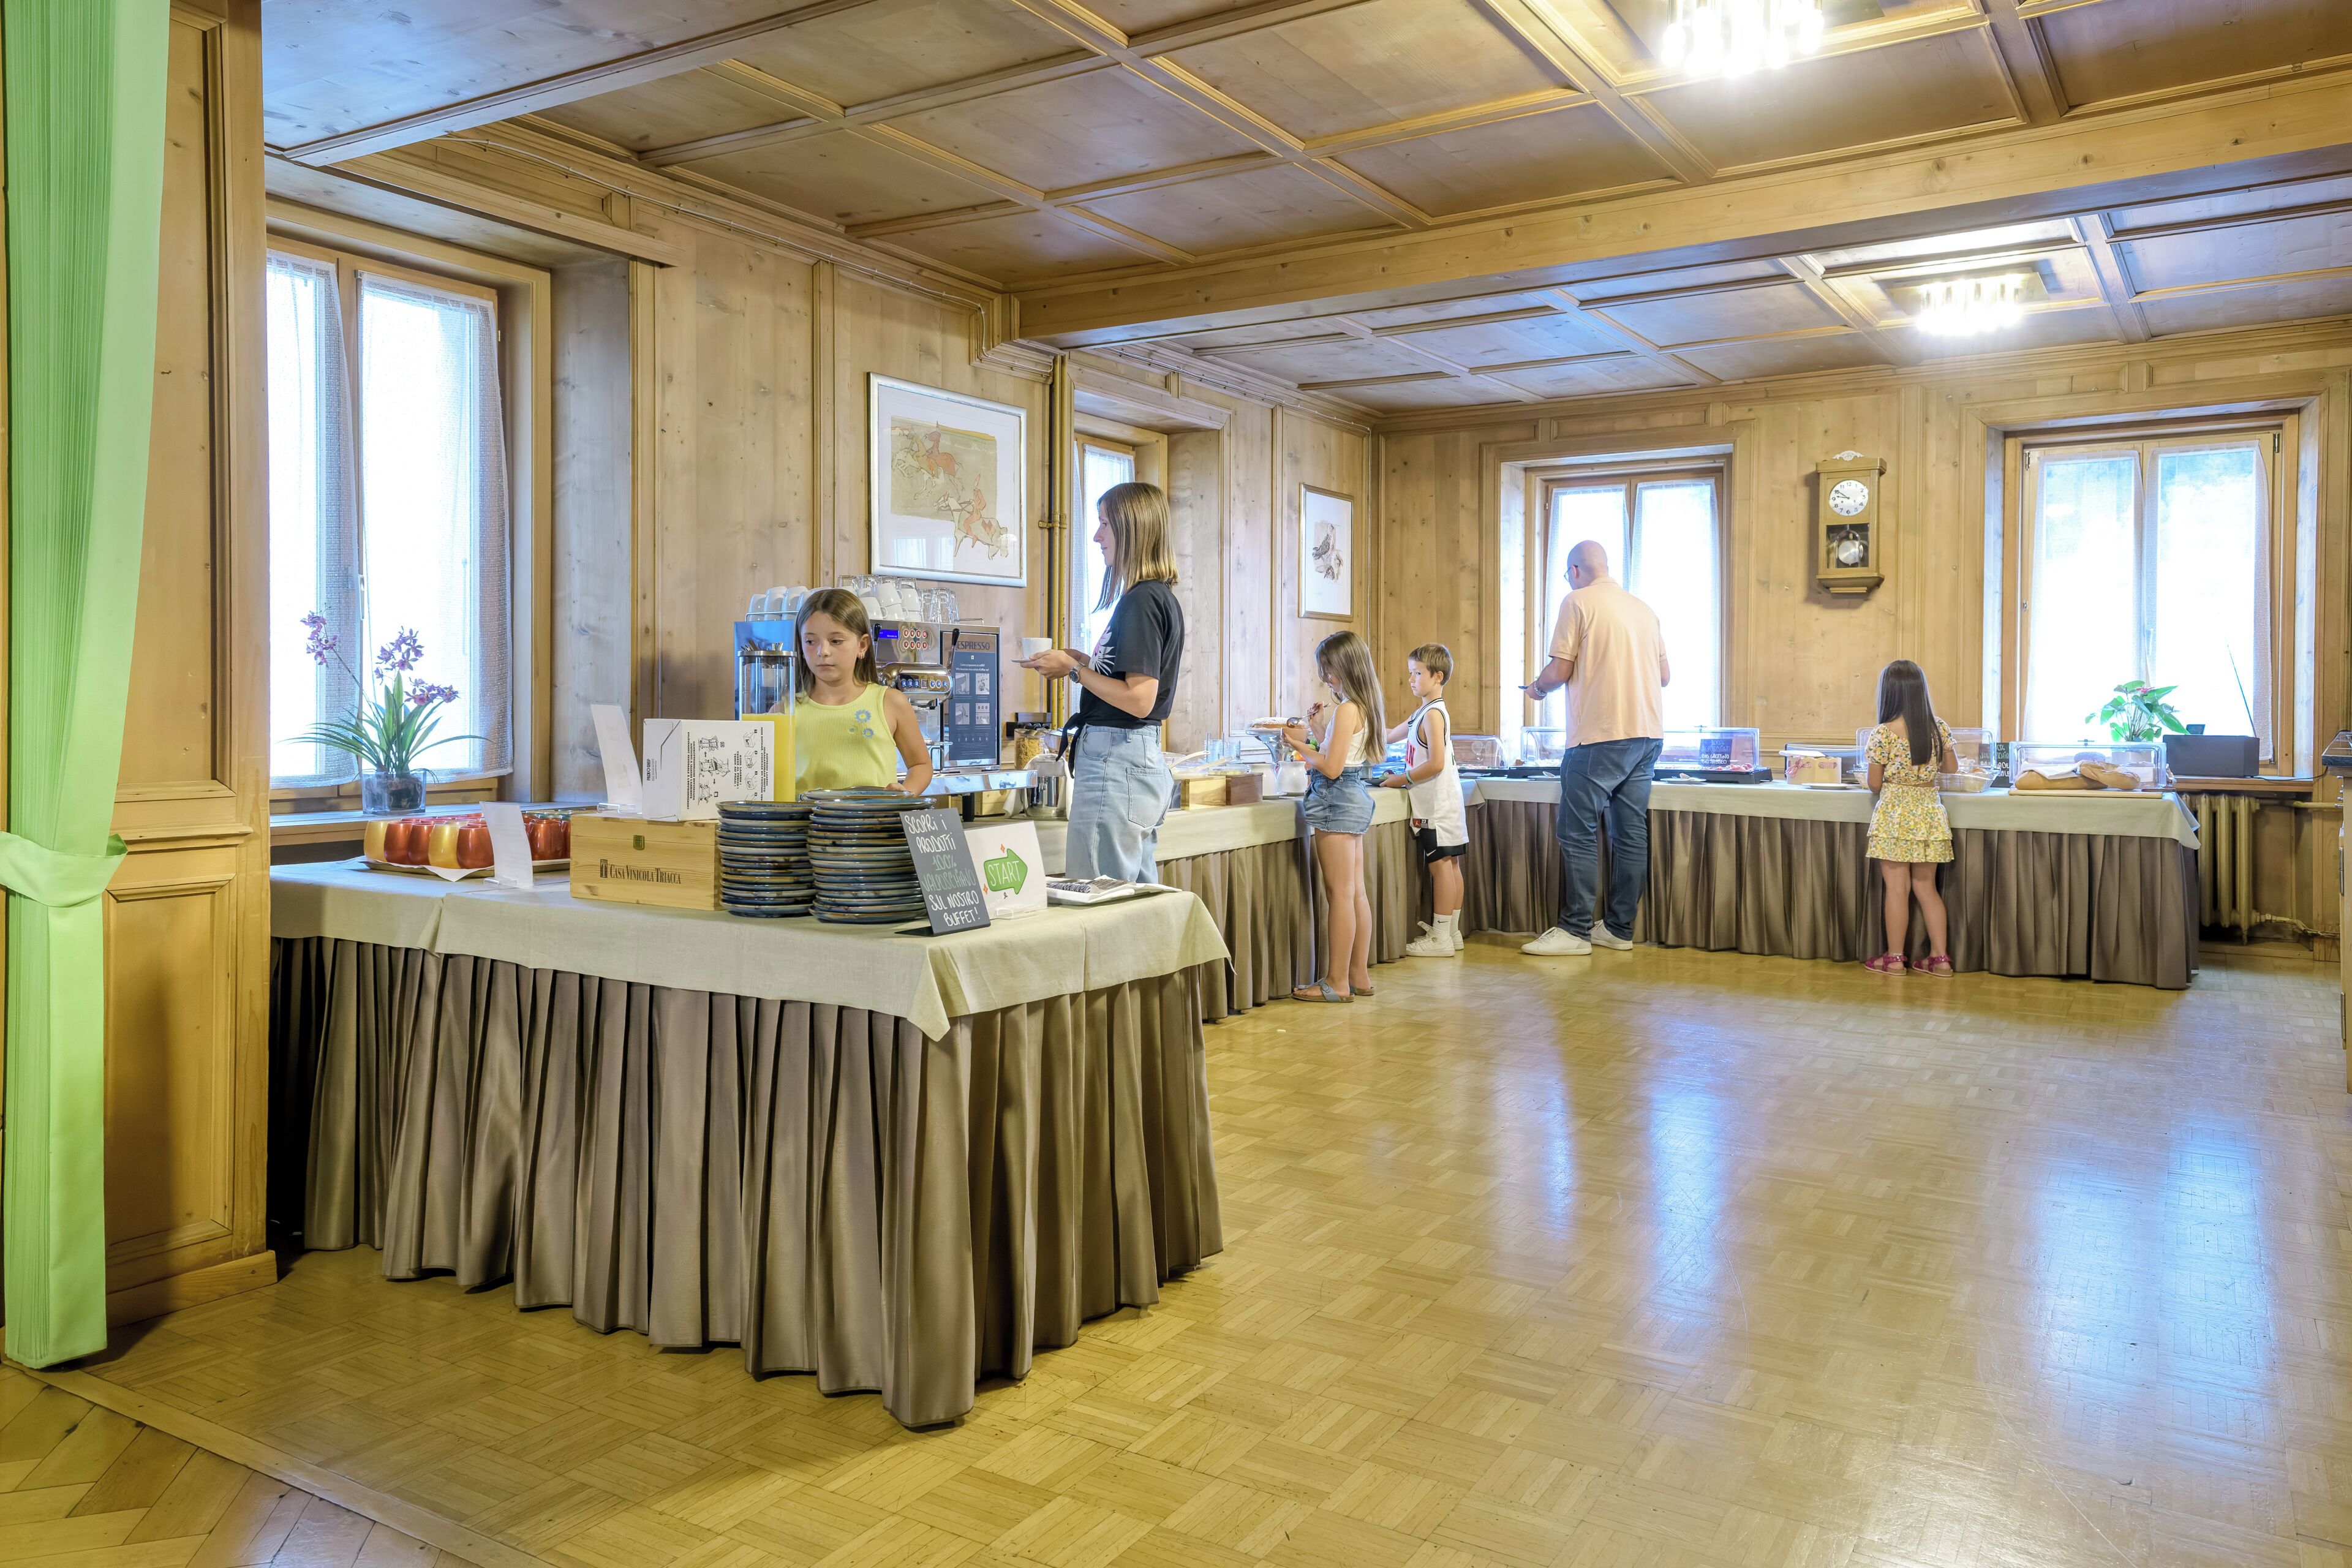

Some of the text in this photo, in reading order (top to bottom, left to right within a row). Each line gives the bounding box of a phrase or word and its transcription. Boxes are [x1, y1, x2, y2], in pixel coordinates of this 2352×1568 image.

[932, 854, 957, 871] 100%
[988, 861, 1020, 886] START
[929, 890, 979, 911] SUL NOSTRO
